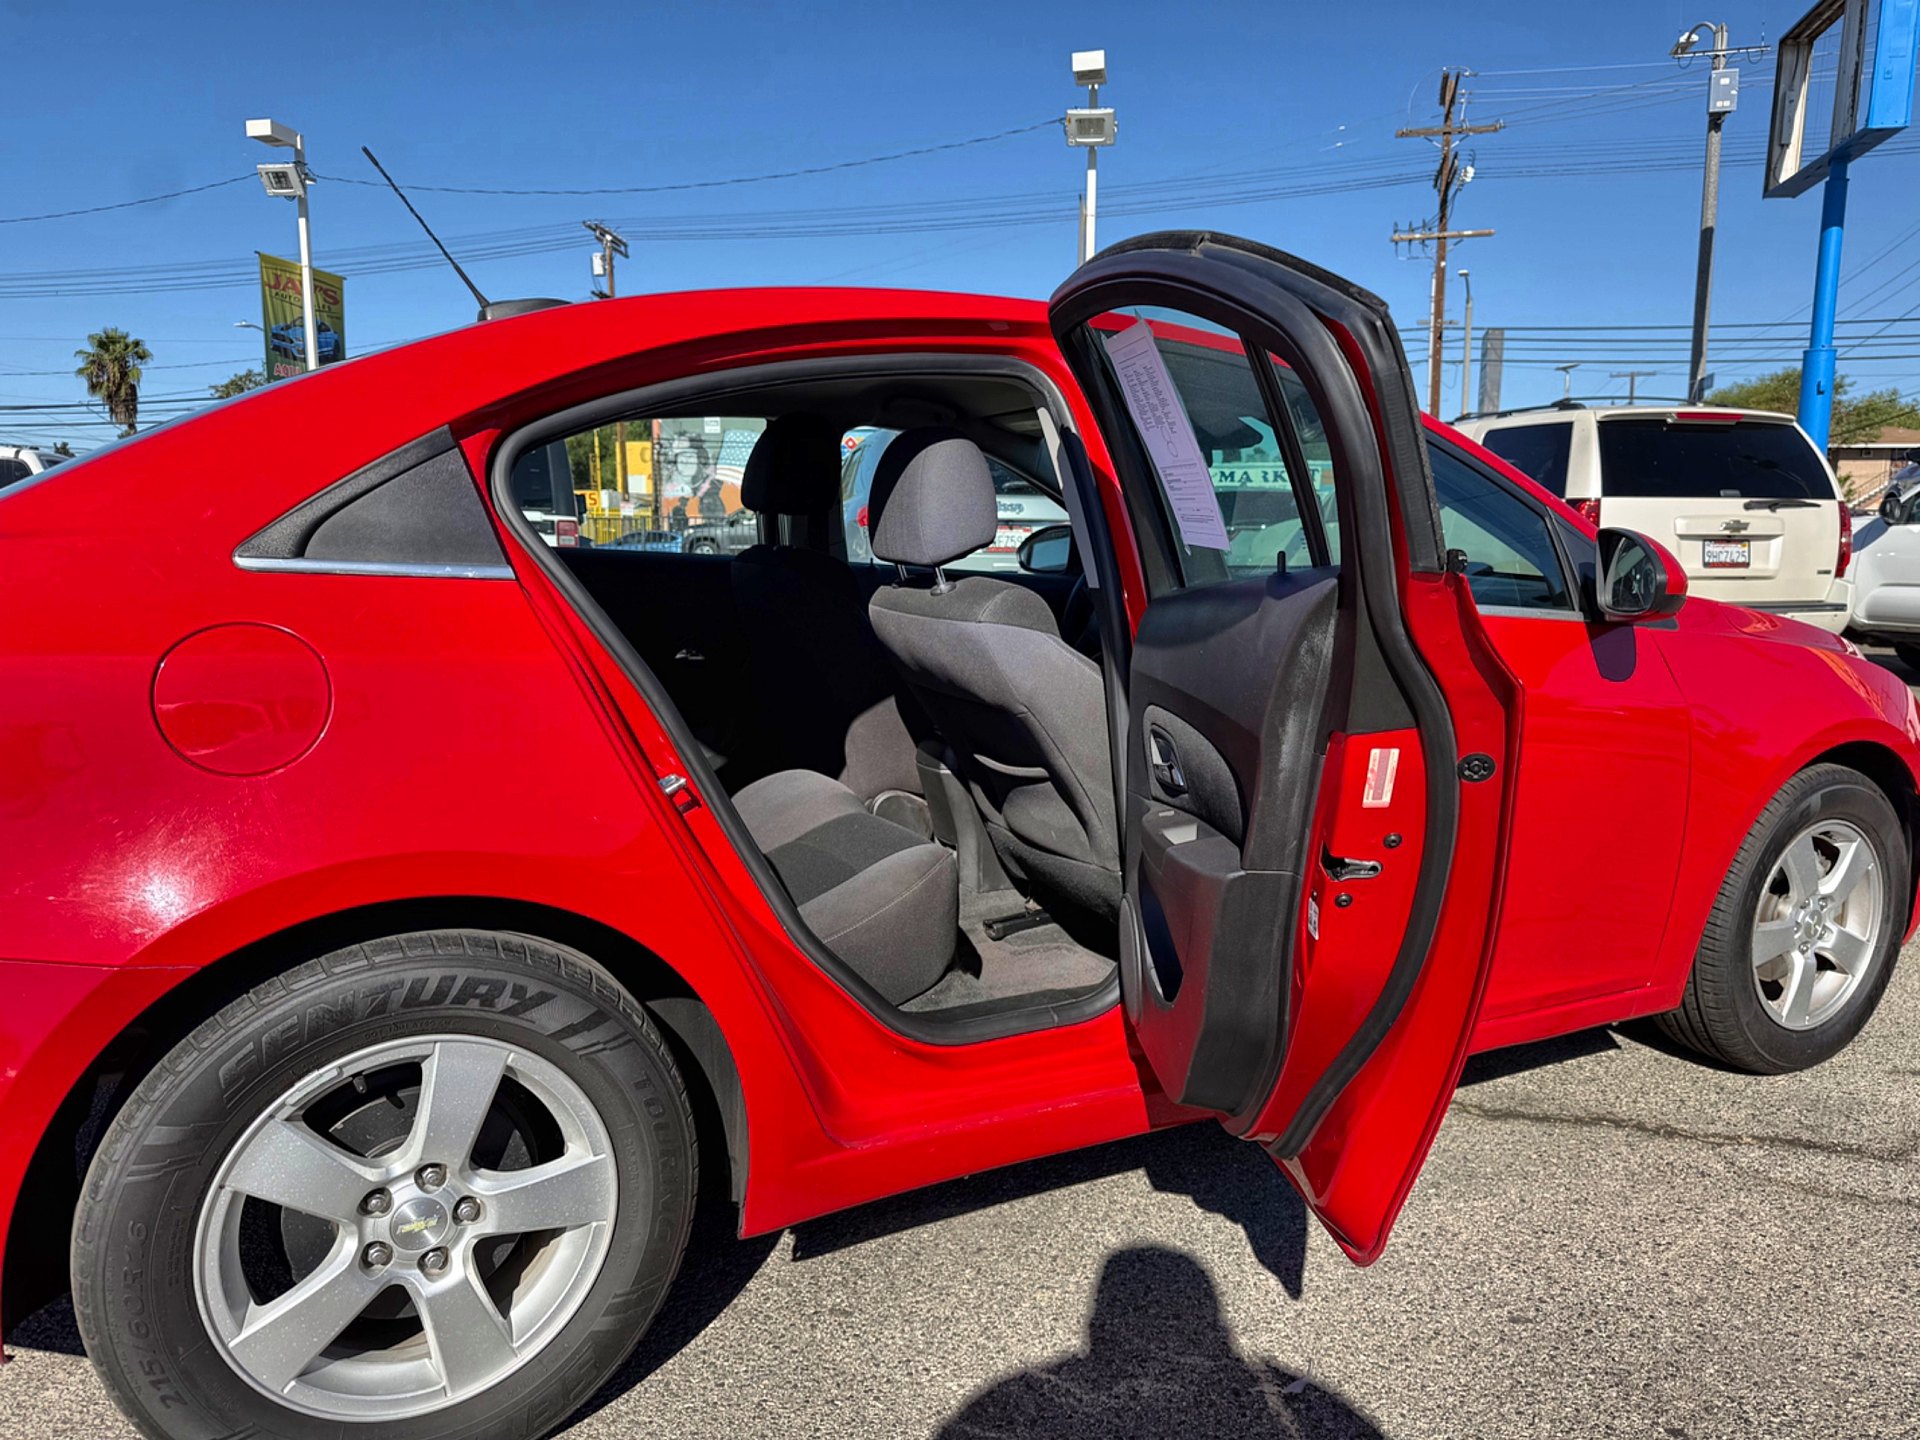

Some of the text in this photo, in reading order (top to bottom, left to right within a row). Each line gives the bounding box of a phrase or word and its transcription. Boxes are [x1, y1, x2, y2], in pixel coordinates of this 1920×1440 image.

[1218, 468, 1320, 483] MARKT
[218, 974, 557, 1093] SENTURY
[632, 1070, 673, 1244] TOURING
